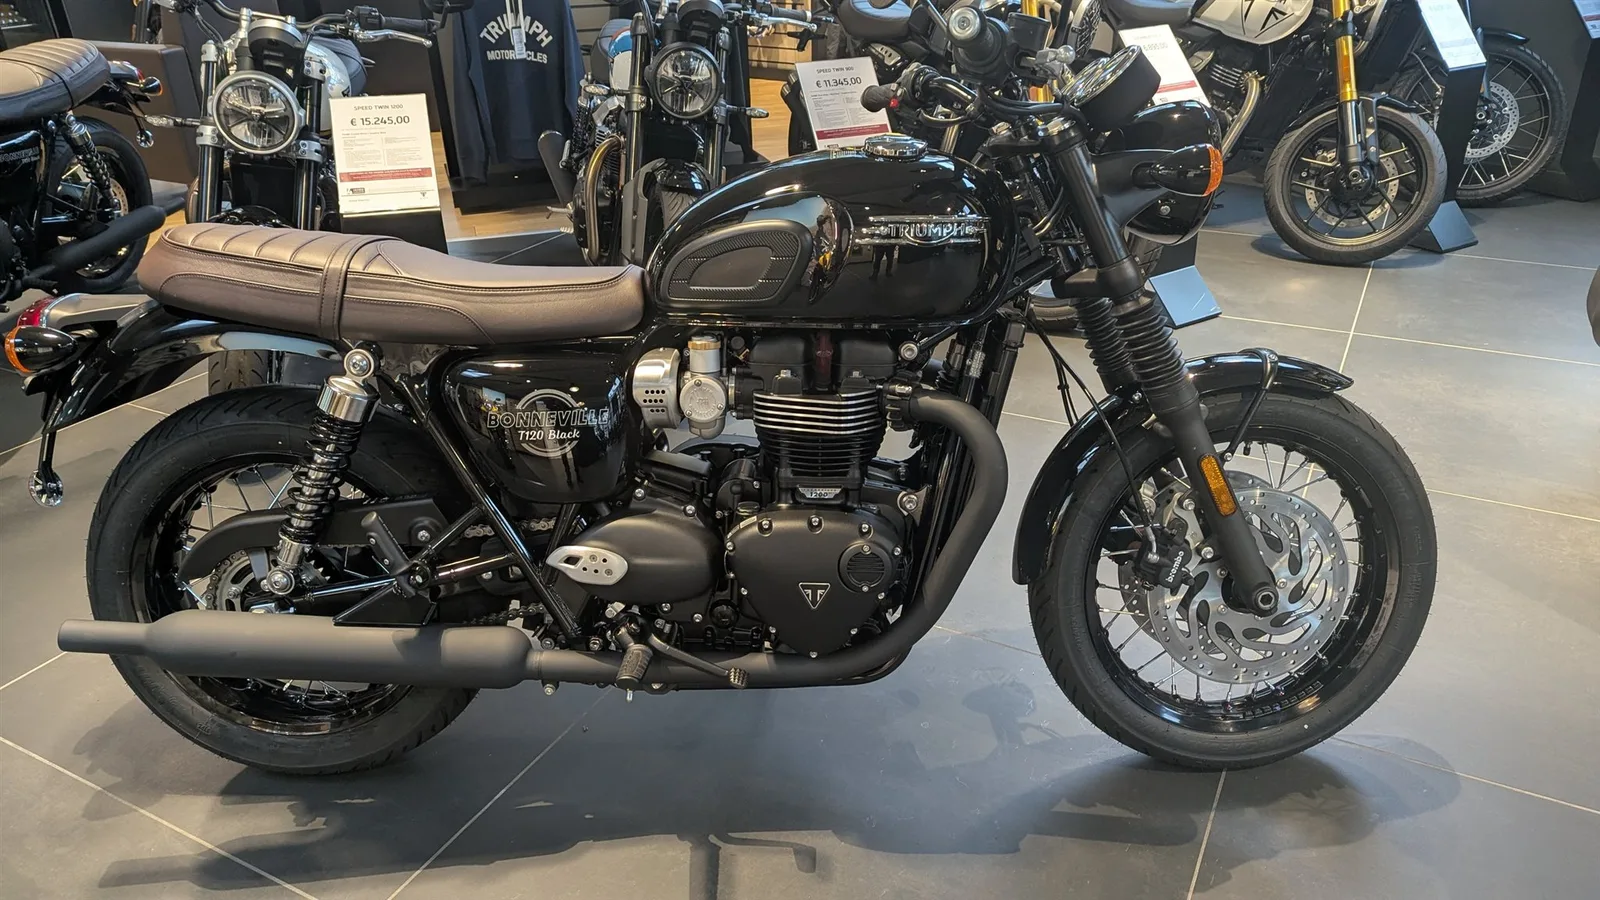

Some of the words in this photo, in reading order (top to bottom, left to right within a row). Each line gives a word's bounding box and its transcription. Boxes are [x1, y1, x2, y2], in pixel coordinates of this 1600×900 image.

[486, 49, 548, 64] MOTORCLES
[816, 80, 822, 88] €
[823, 77, 862, 87] 11.345,00
[350, 117, 357, 126] €
[360, 115, 410, 126] 15.245,00
[888, 223, 965, 237] TRIUMPH
[487, 409, 609, 428] BONNEVILLE
[518, 430, 544, 440] T120
[548, 428, 580, 440] Black
[1165, 551, 1184, 582] brembo
